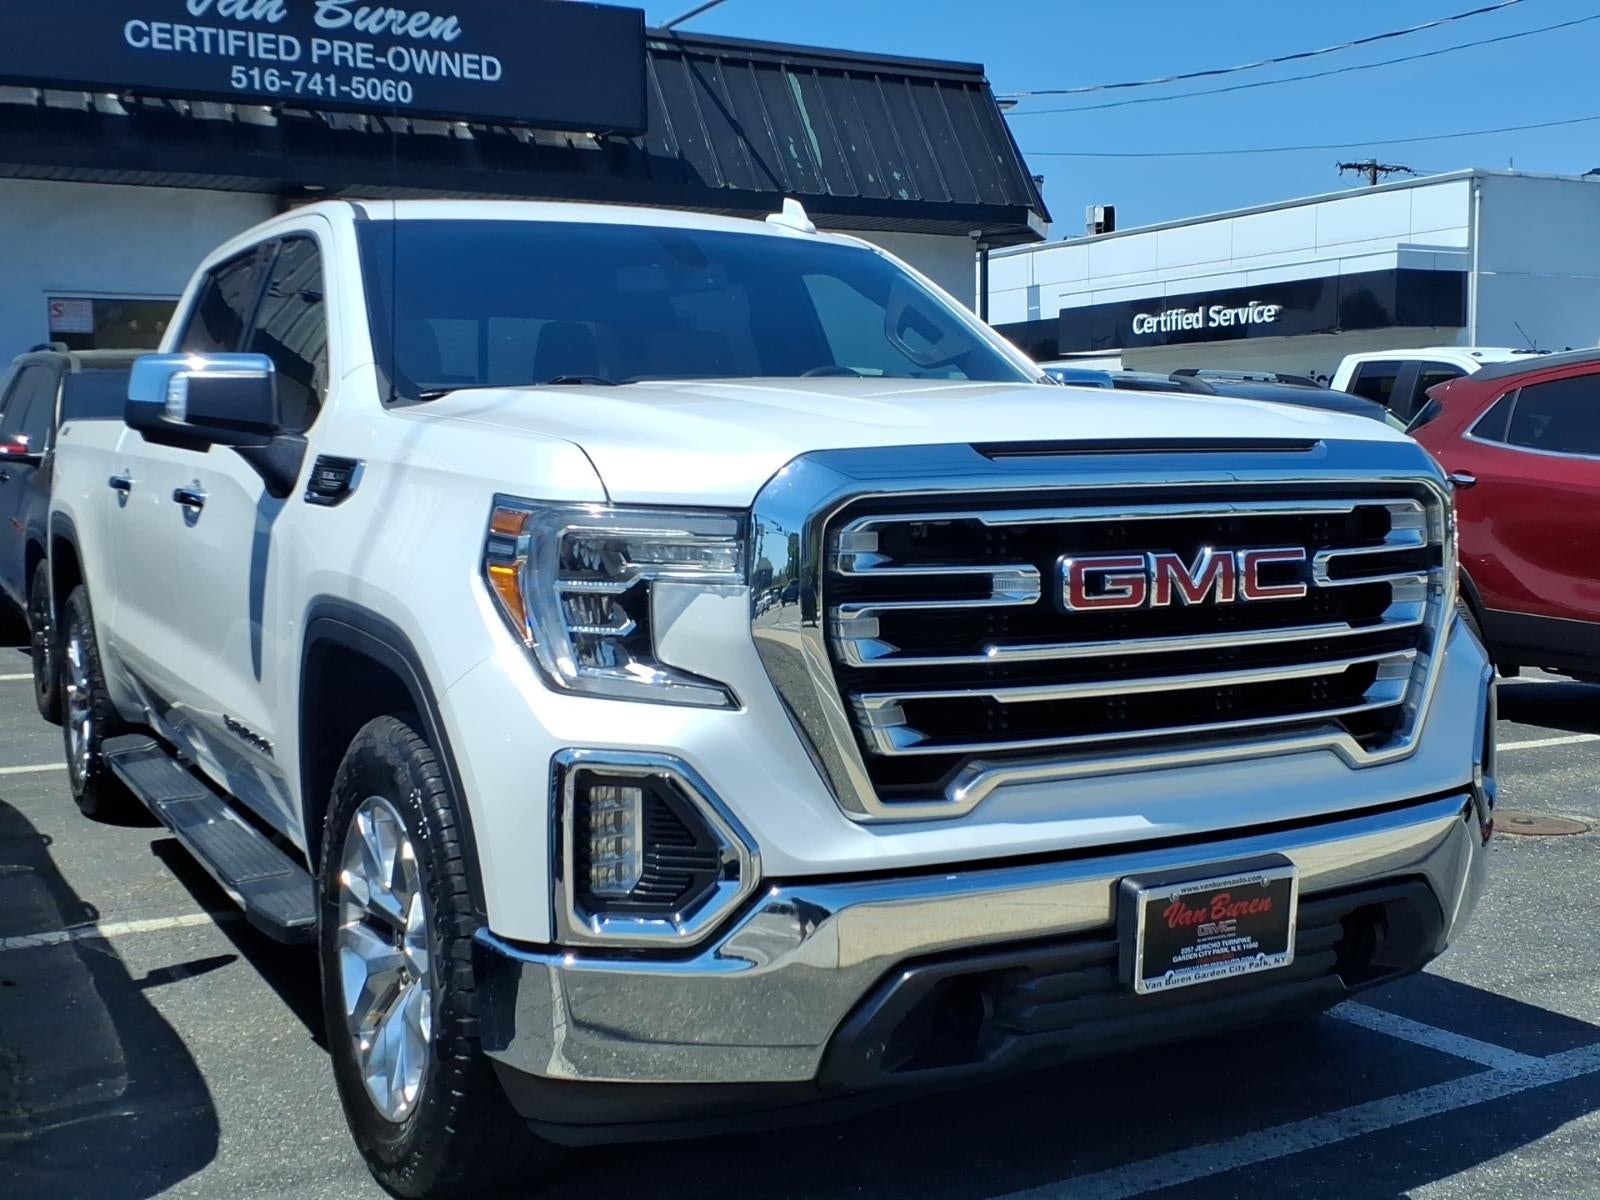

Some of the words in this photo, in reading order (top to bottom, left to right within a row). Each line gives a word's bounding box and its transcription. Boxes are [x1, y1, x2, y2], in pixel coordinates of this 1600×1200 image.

[314, 0, 462, 41] Buren
[124, 19, 301, 61] CERTIFIED
[311, 37, 503, 82] PRE-OWNED
[230, 65, 413, 104] 516-741-5060
[1132, 305, 1205, 335] Certified
[1208, 300, 1283, 328] Service
[1056, 546, 1307, 612] GMC
[1162, 901, 1207, 928] Van
[1210, 893, 1272, 919] Buren
[1144, 981, 1162, 991] Van
[1165, 973, 1192, 986] Buren
[1194, 969, 1227, 981] Garden
[1229, 963, 1246, 974] City
[1274, 955, 1287, 965] NY
